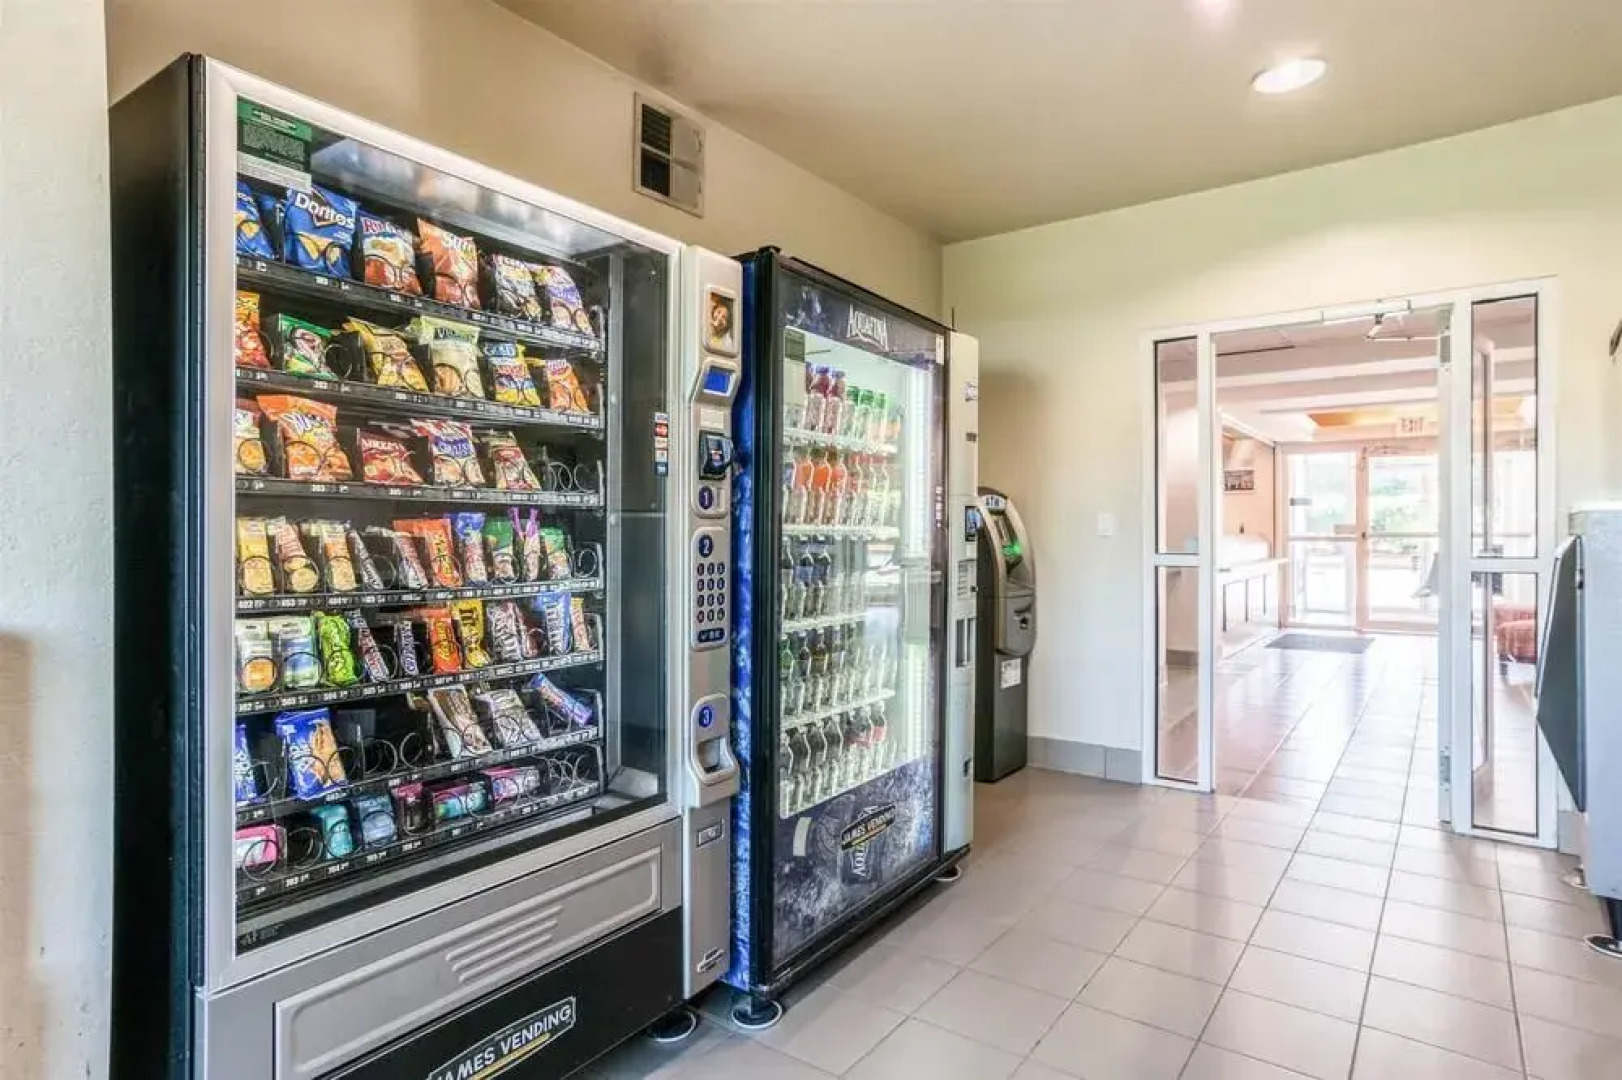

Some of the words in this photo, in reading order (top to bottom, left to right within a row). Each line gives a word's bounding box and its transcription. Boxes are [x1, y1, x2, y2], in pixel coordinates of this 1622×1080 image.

[295, 192, 355, 229] Doritos
[1400, 415, 1424, 433] EXIT
[500, 1004, 572, 1055] VENDING
